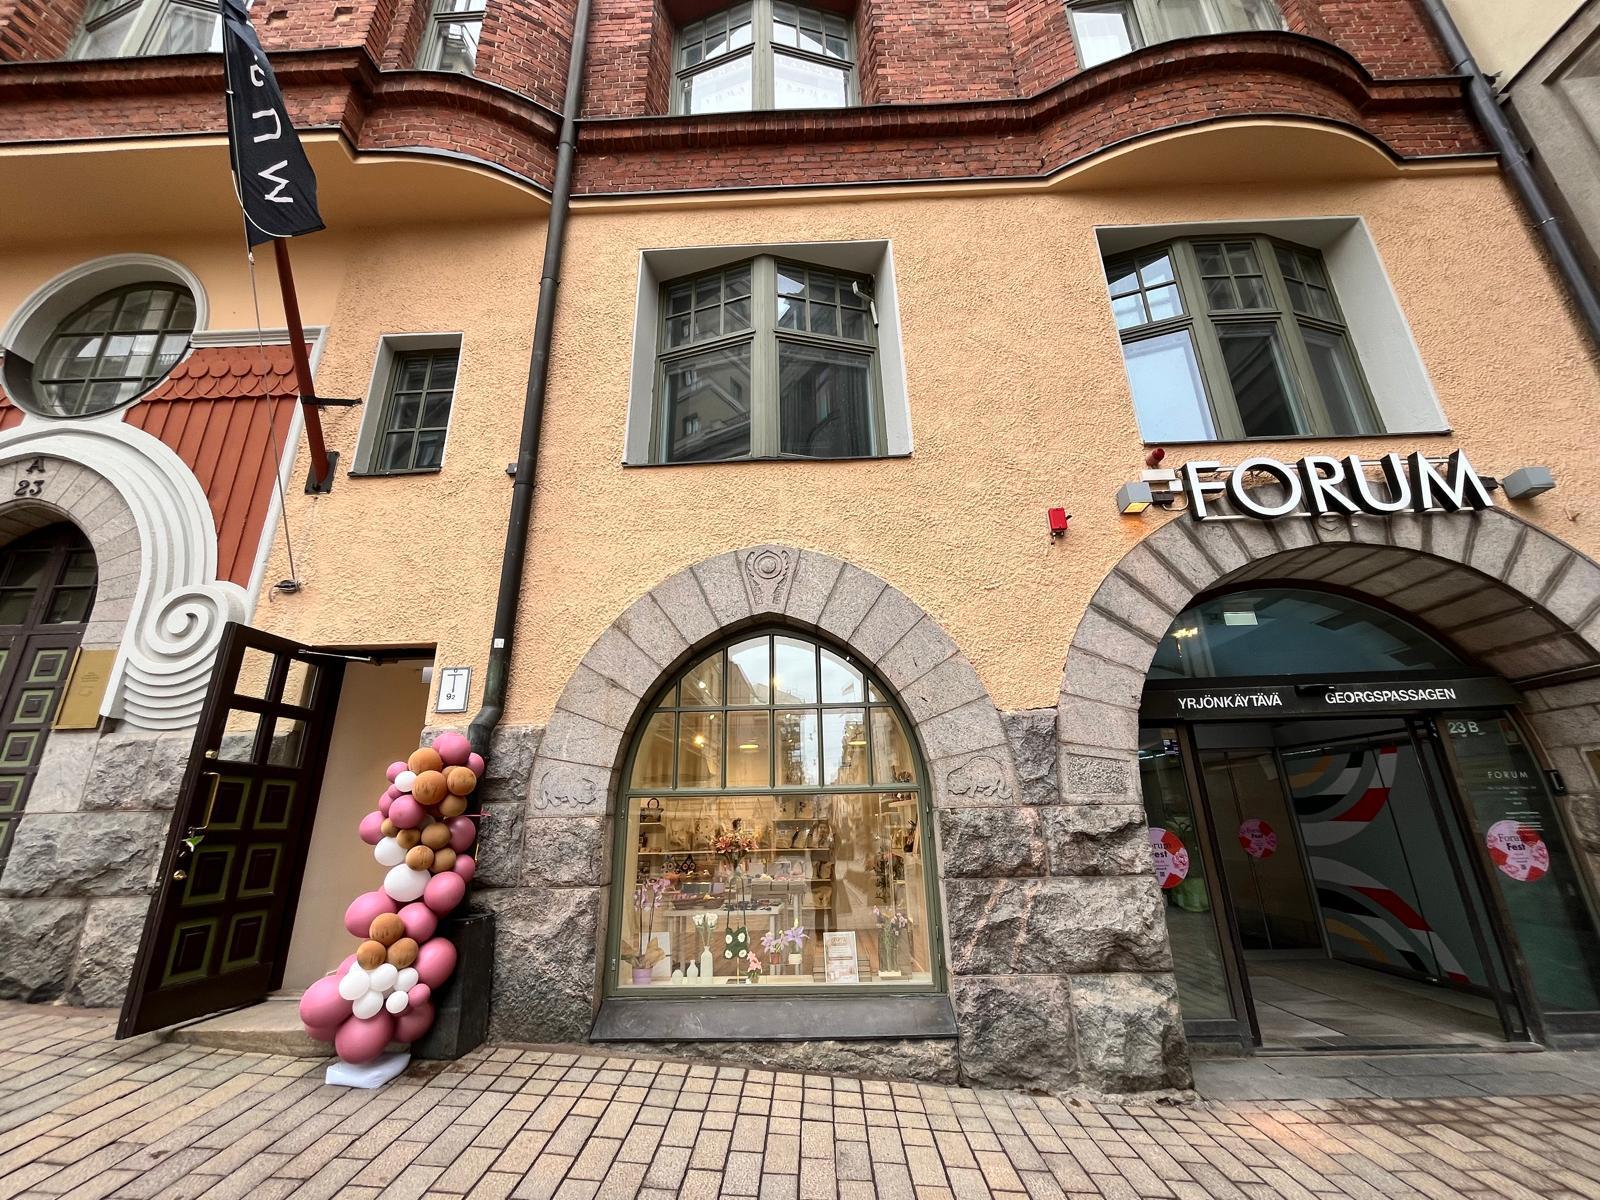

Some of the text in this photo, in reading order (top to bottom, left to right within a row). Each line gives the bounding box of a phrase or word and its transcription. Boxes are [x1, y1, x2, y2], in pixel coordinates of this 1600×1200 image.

[26, 457, 46, 474] A
[14, 479, 45, 496] 23
[1183, 449, 1494, 520] FORUM
[1178, 688, 1457, 710] YRJÖNKÄYTÄVÄ GEORGSPASSAGEN
[1448, 721, 1480, 734] 23 B
[1487, 770, 1529, 779] FORUM
[1506, 842, 1526, 851] Fest
